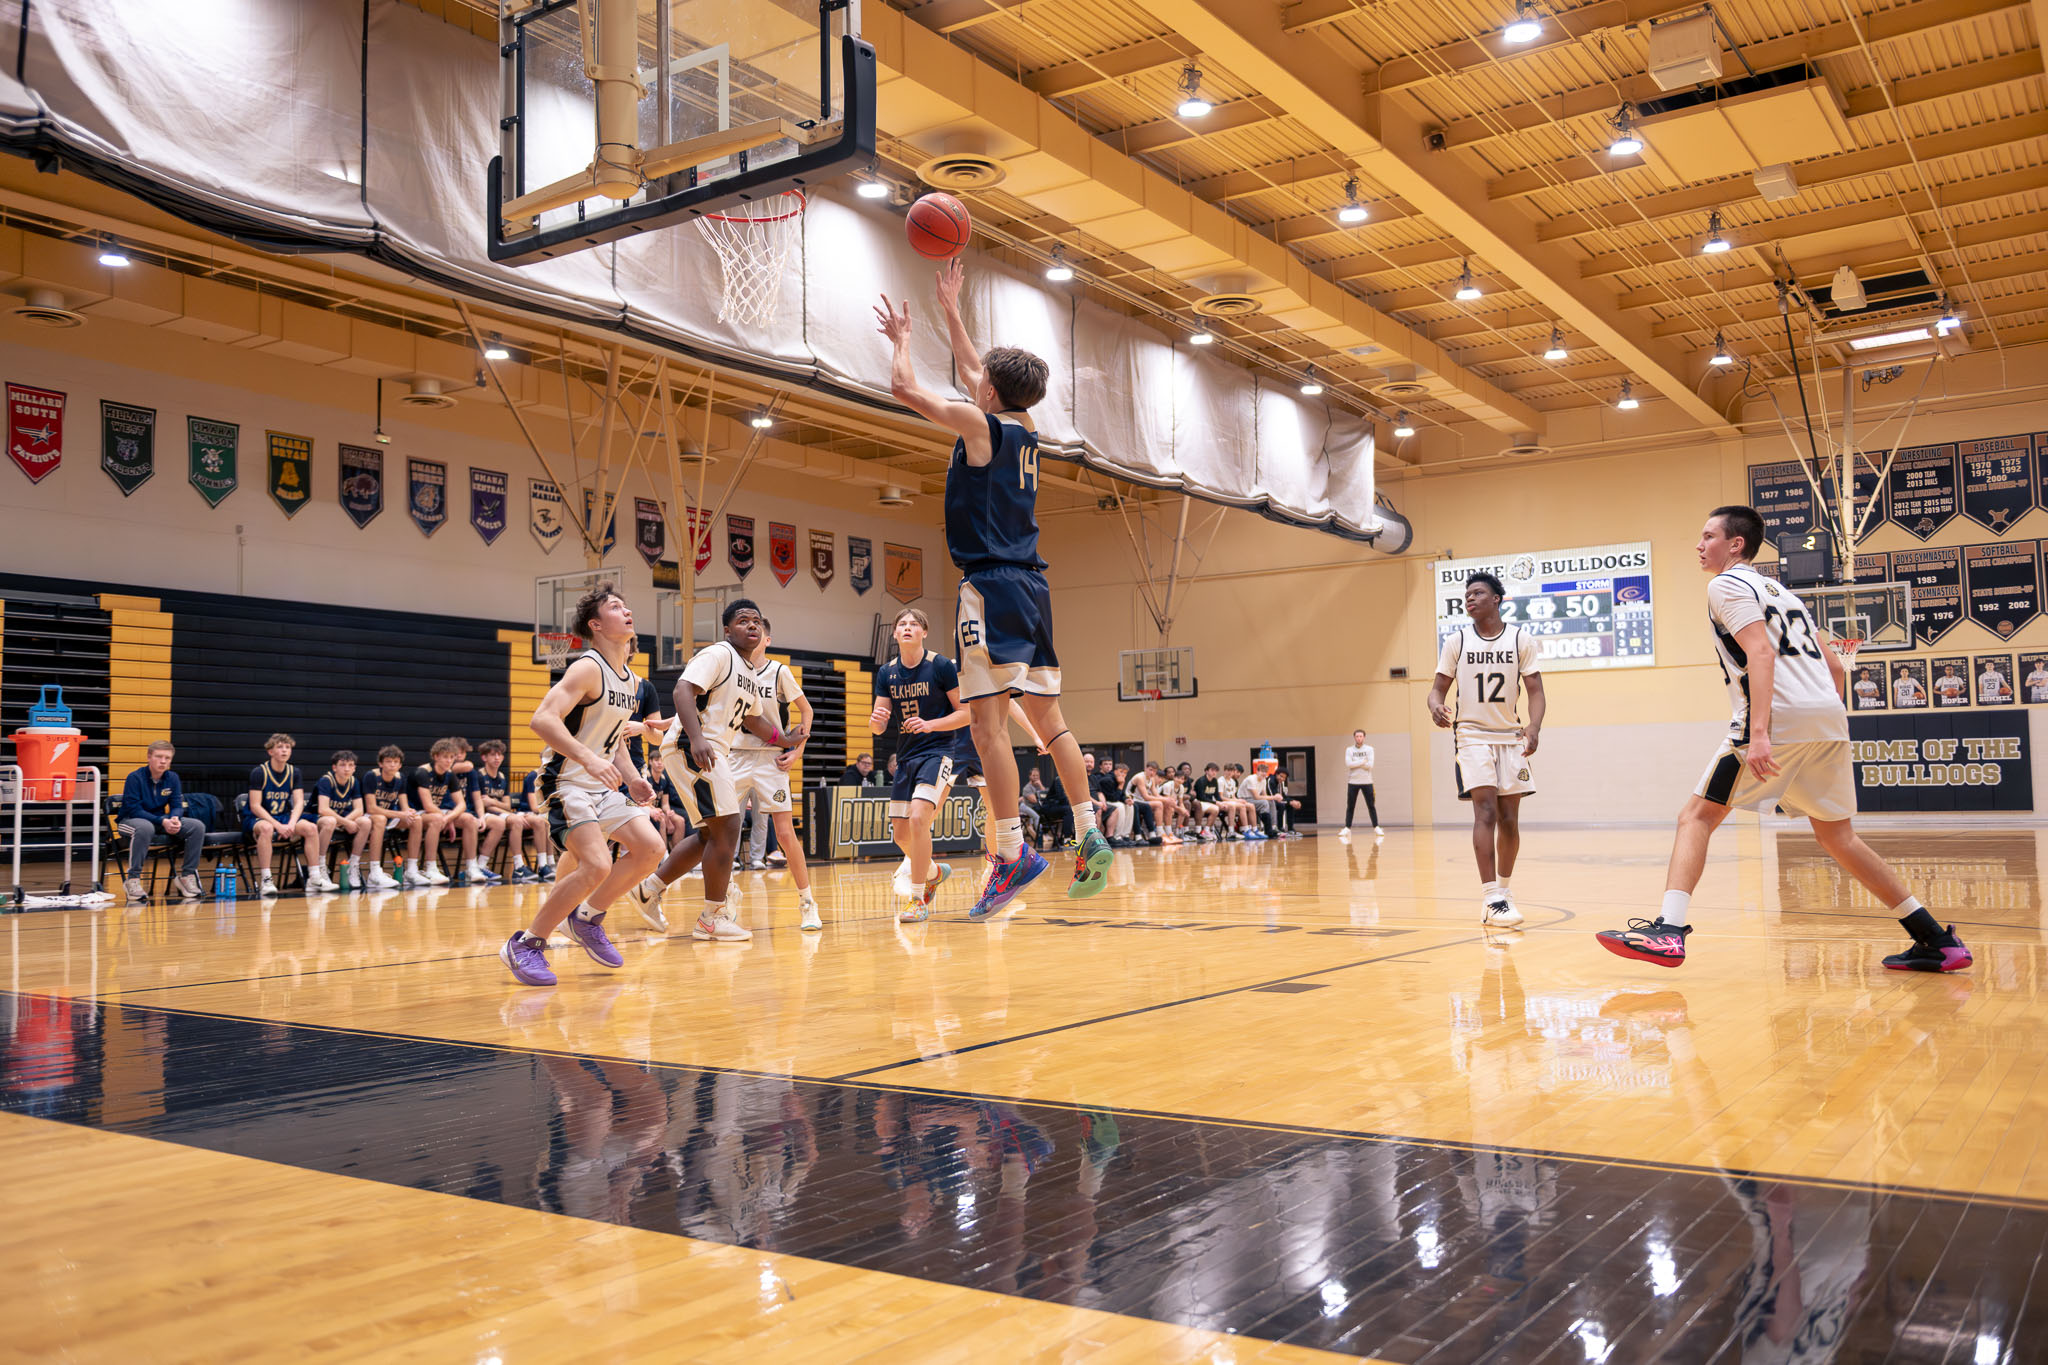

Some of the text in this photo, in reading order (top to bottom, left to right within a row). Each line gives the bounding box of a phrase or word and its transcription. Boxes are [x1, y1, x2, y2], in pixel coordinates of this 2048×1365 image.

[11, 391, 62, 408] MILLARD
[16, 405, 57, 419] SOUTH
[104, 407, 151, 425] MILLARD
[111, 420, 145, 436] WEST
[272, 437, 309, 451] OMAHA
[1974, 440, 2015, 453] BASEBALL
[13, 444, 60, 463] PATRIOTS
[272, 446, 308, 461] BRYAN
[1901, 449, 1943, 462] WRESTLING
[1965, 449, 2027, 464] STATE CHAMPIONS
[1020, 444, 1039, 492] 14
[1892, 458, 1951, 472] STATE CHAMPIONS
[1971, 458, 2021, 470] 1970 1975
[474, 473, 504, 486] OMAHA
[1906, 470, 1936, 481] 2000 TEAM
[1971, 466, 2022, 479] 1979 1992
[1986, 475, 2008, 484] 2000
[1906, 479, 1924, 488] 2013
[1966, 478, 2028, 493] STATE RUNNER-UP
[532, 491, 561, 503] MARIAN
[1761, 488, 1804, 499] 1977 1986
[1893, 486, 1953, 500] STATE RUNNER-UP
[1894, 501, 1910, 510] 2012
[1910, 500, 1922, 509] TEAM
[1924, 498, 1940, 507] 2015
[1894, 503, 1953, 517] 2013 TEAM 2019 TEAM
[476, 517, 502, 530] EAGLES
[1786, 516, 1805, 525] 2000
[1896, 549, 1957, 564] BOYS GYMNASTICS
[1981, 544, 2020, 557] SOFTBALL
[1540, 552, 1648, 576] BULLDOGS
[1896, 560, 1956, 573] STATE RUNNER-UP
[1970, 554, 2033, 568] STATE CHAMPIONS
[1757, 565, 1775, 577] GIRLS
[1576, 580, 1610, 591] STORM
[1916, 575, 1938, 585] 1983
[1917, 585, 1959, 599] GYMNASTICS
[1972, 584, 2035, 598] STATE RUNNER-UP
[1566, 595, 1600, 617] 50
[1920, 597, 1959, 608] RUNNER-UP
[1978, 600, 2031, 612] 1992 2002
[1933, 611, 1954, 621] 1976
[1521, 620, 1564, 636] 07:29
[1596, 622, 1605, 632] 0
[1764, 605, 1822, 660] 23
[1537, 636, 1601, 660] DOGS
[1467, 651, 1514, 665] BURKE
[890, 681, 930, 700] ELKHORN
[1474, 672, 1506, 703] 12
[1986, 682, 1997, 690] 23
[607, 689, 636, 710] BURKE
[1859, 700, 1886, 708] PARKS
[1978, 695, 2012, 703] RUMMEL
[1850, 737, 2021, 762] HOME OF THE
[1861, 763, 2002, 787] BULLDOGS
[838, 797, 973, 845] BURKE DOGS
